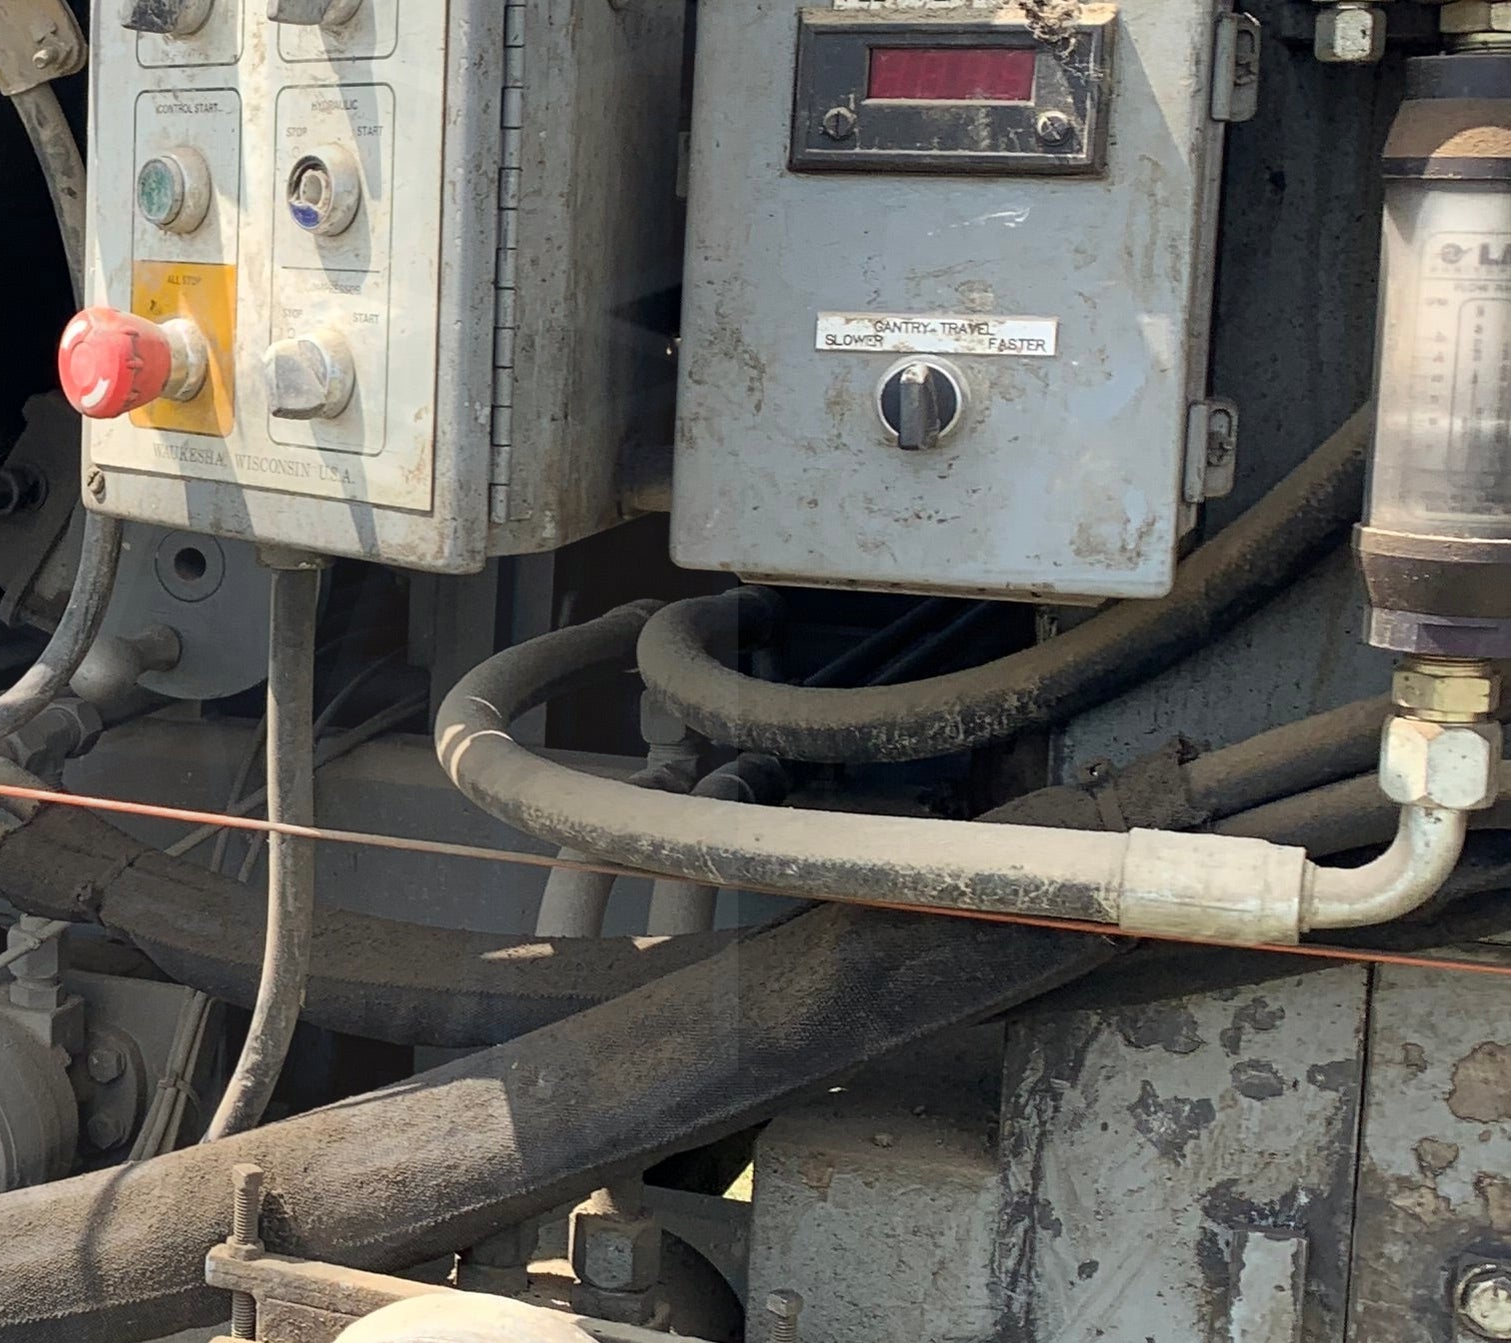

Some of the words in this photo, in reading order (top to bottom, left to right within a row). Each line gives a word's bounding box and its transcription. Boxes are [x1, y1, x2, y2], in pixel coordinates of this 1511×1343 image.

[155, 103, 193, 115] CONTROL
[194, 102, 219, 114] START
[311, 99, 359, 112] HYDRAULIC
[285, 126, 308, 138] STOP
[357, 125, 384, 137] START
[352, 312, 380, 324] START
[874, 320, 930, 334] GANTRY
[939, 322, 996, 336] TRAVEL
[824, 334, 884, 348] SLOWER
[989, 337, 1047, 352] FASTER
[234, 453, 312, 478] WISCONSIN
